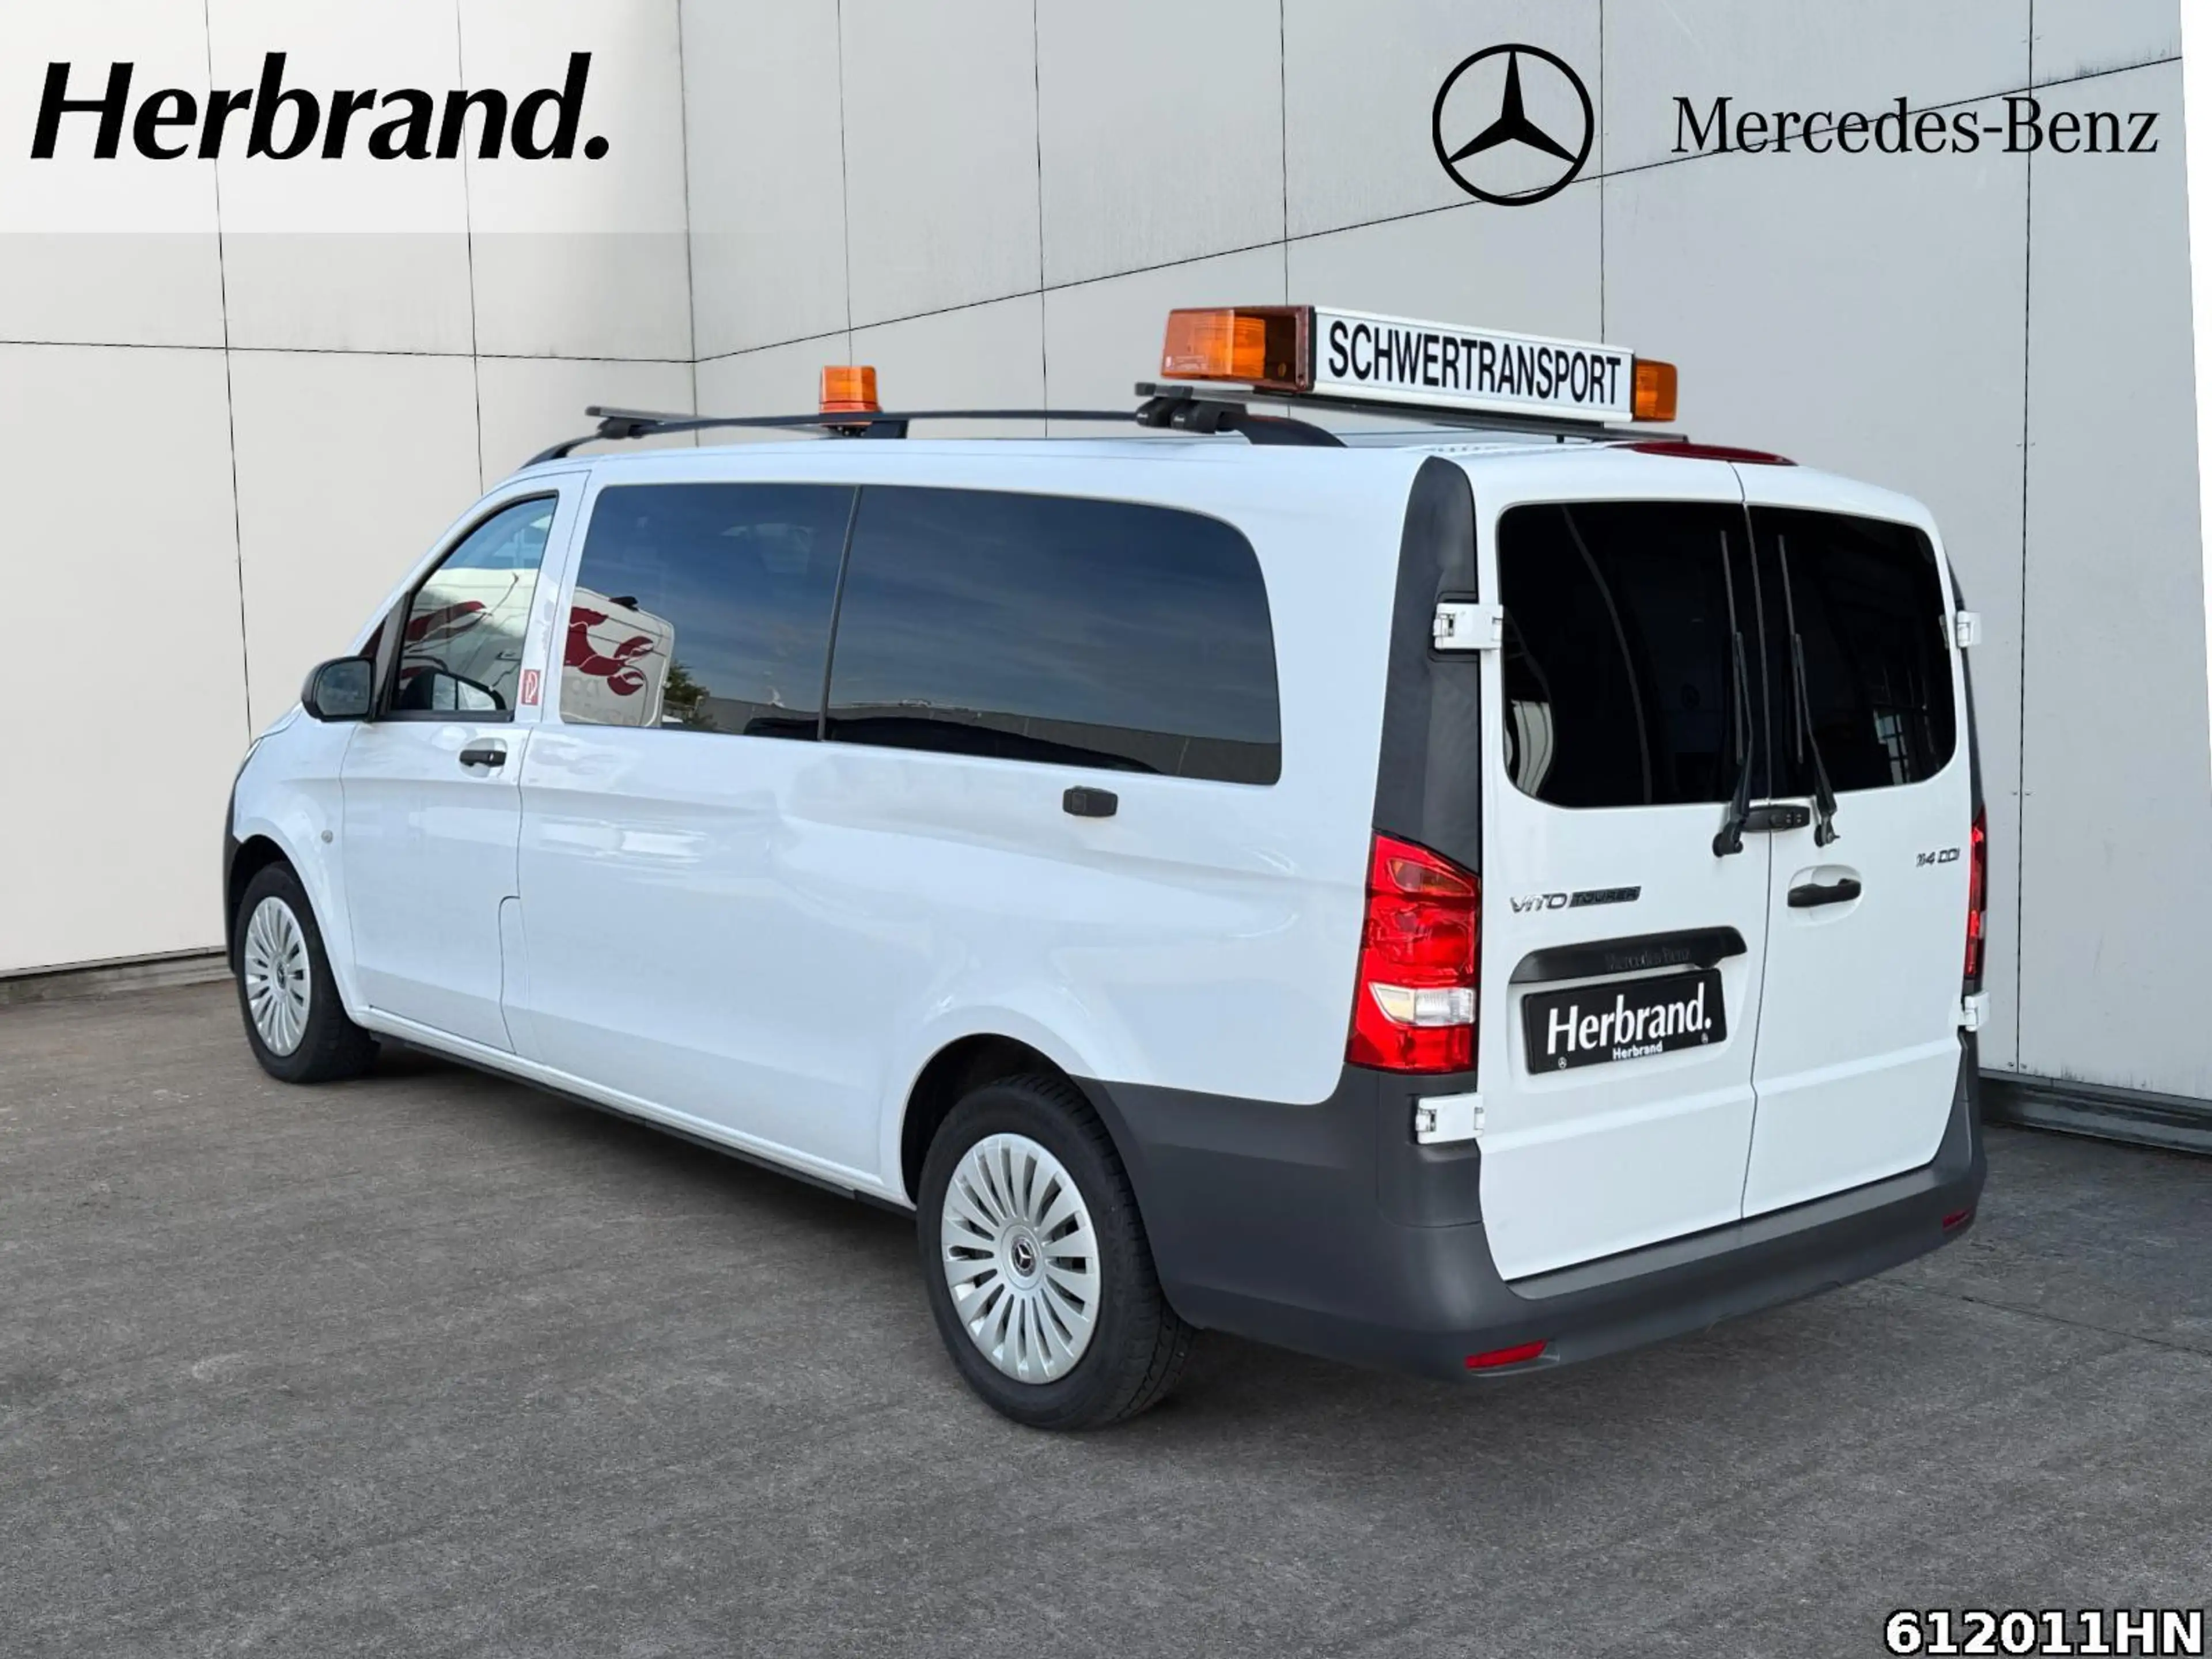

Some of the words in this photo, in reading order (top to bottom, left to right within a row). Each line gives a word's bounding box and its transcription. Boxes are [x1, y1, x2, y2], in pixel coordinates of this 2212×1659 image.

[1328, 320, 1622, 405] SCHWERTRANSPORT
[1509, 892, 1568, 914] VITO
[1547, 982, 1712, 1055] Herbrand.
[1612, 1040, 1663, 1060] Herbrand
